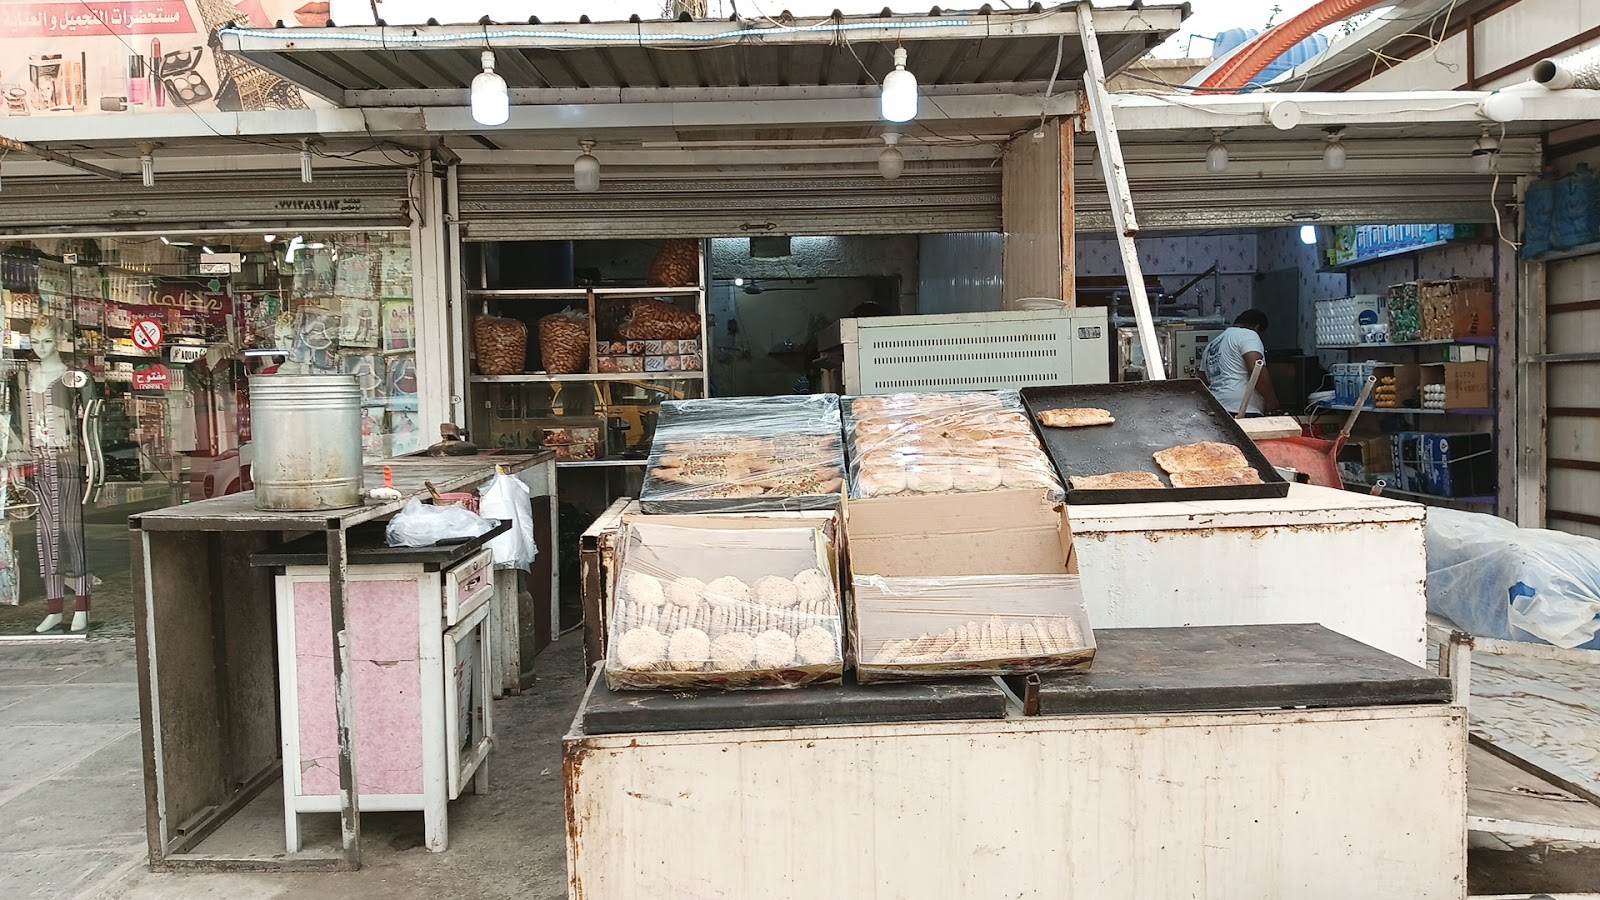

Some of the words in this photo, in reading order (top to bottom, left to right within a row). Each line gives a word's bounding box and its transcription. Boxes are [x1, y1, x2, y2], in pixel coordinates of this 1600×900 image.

[49, 16, 57, 31] و
[59, 8, 109, 32] التجميل
[111, 7, 181, 29] مستحضرات
